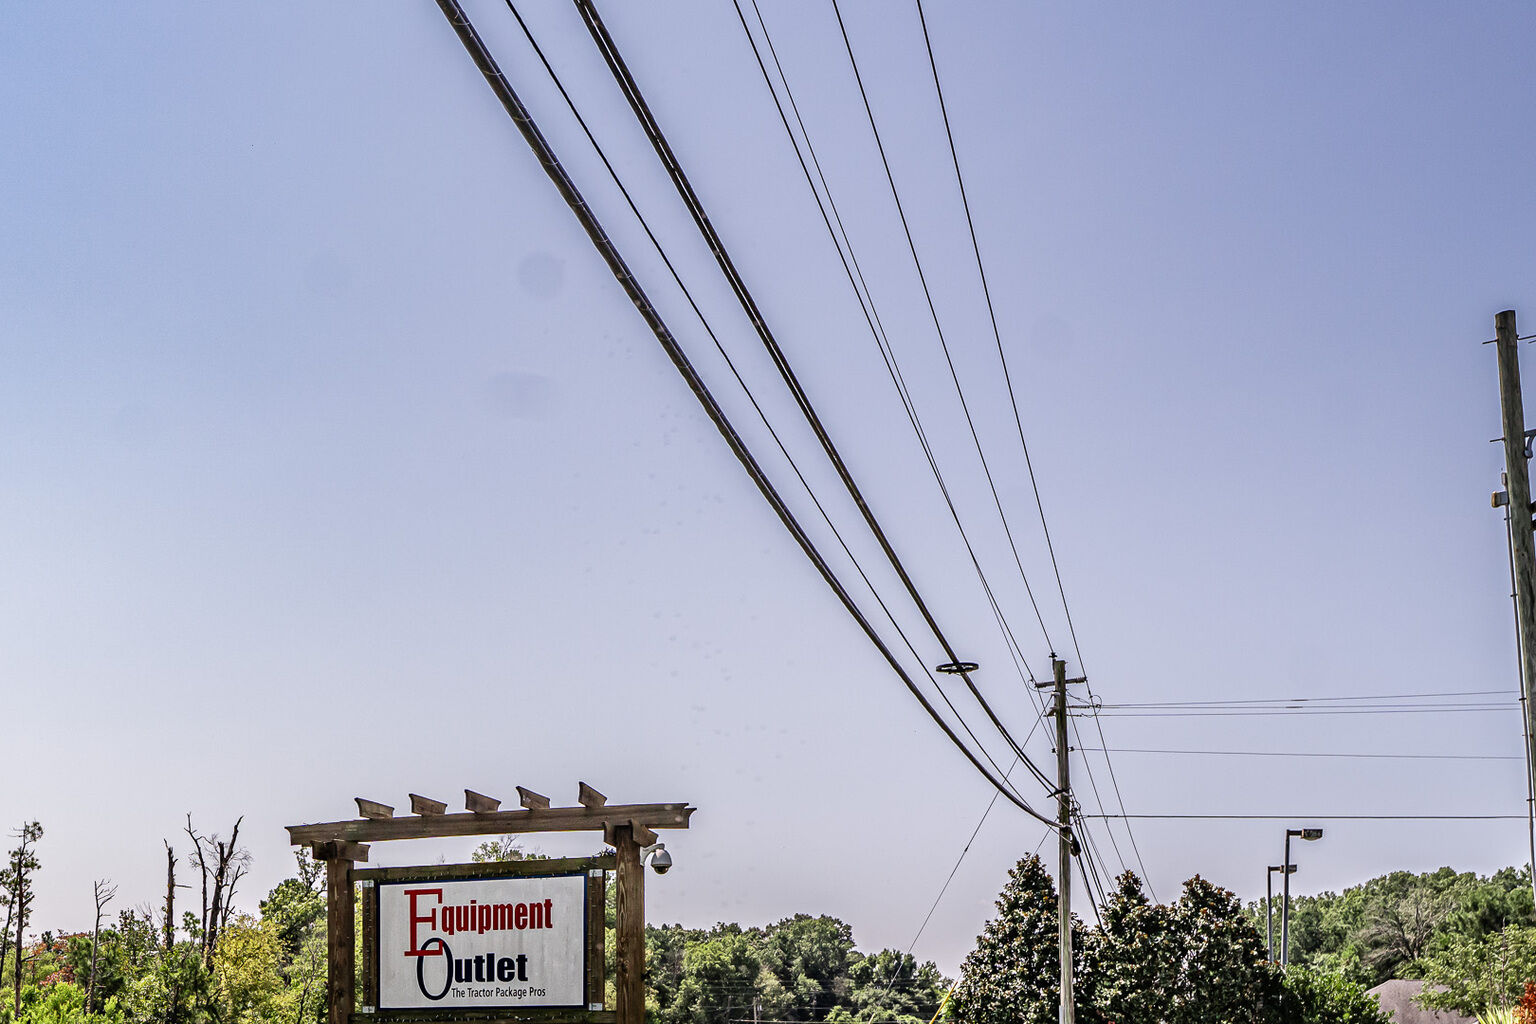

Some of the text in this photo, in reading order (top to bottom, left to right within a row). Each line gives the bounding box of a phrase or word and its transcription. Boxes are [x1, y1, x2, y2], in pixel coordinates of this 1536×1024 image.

[404, 888, 553, 957] Equipment
[416, 937, 528, 1001] Outlet
[451, 986, 546, 1000] The Tractor Package Pros
